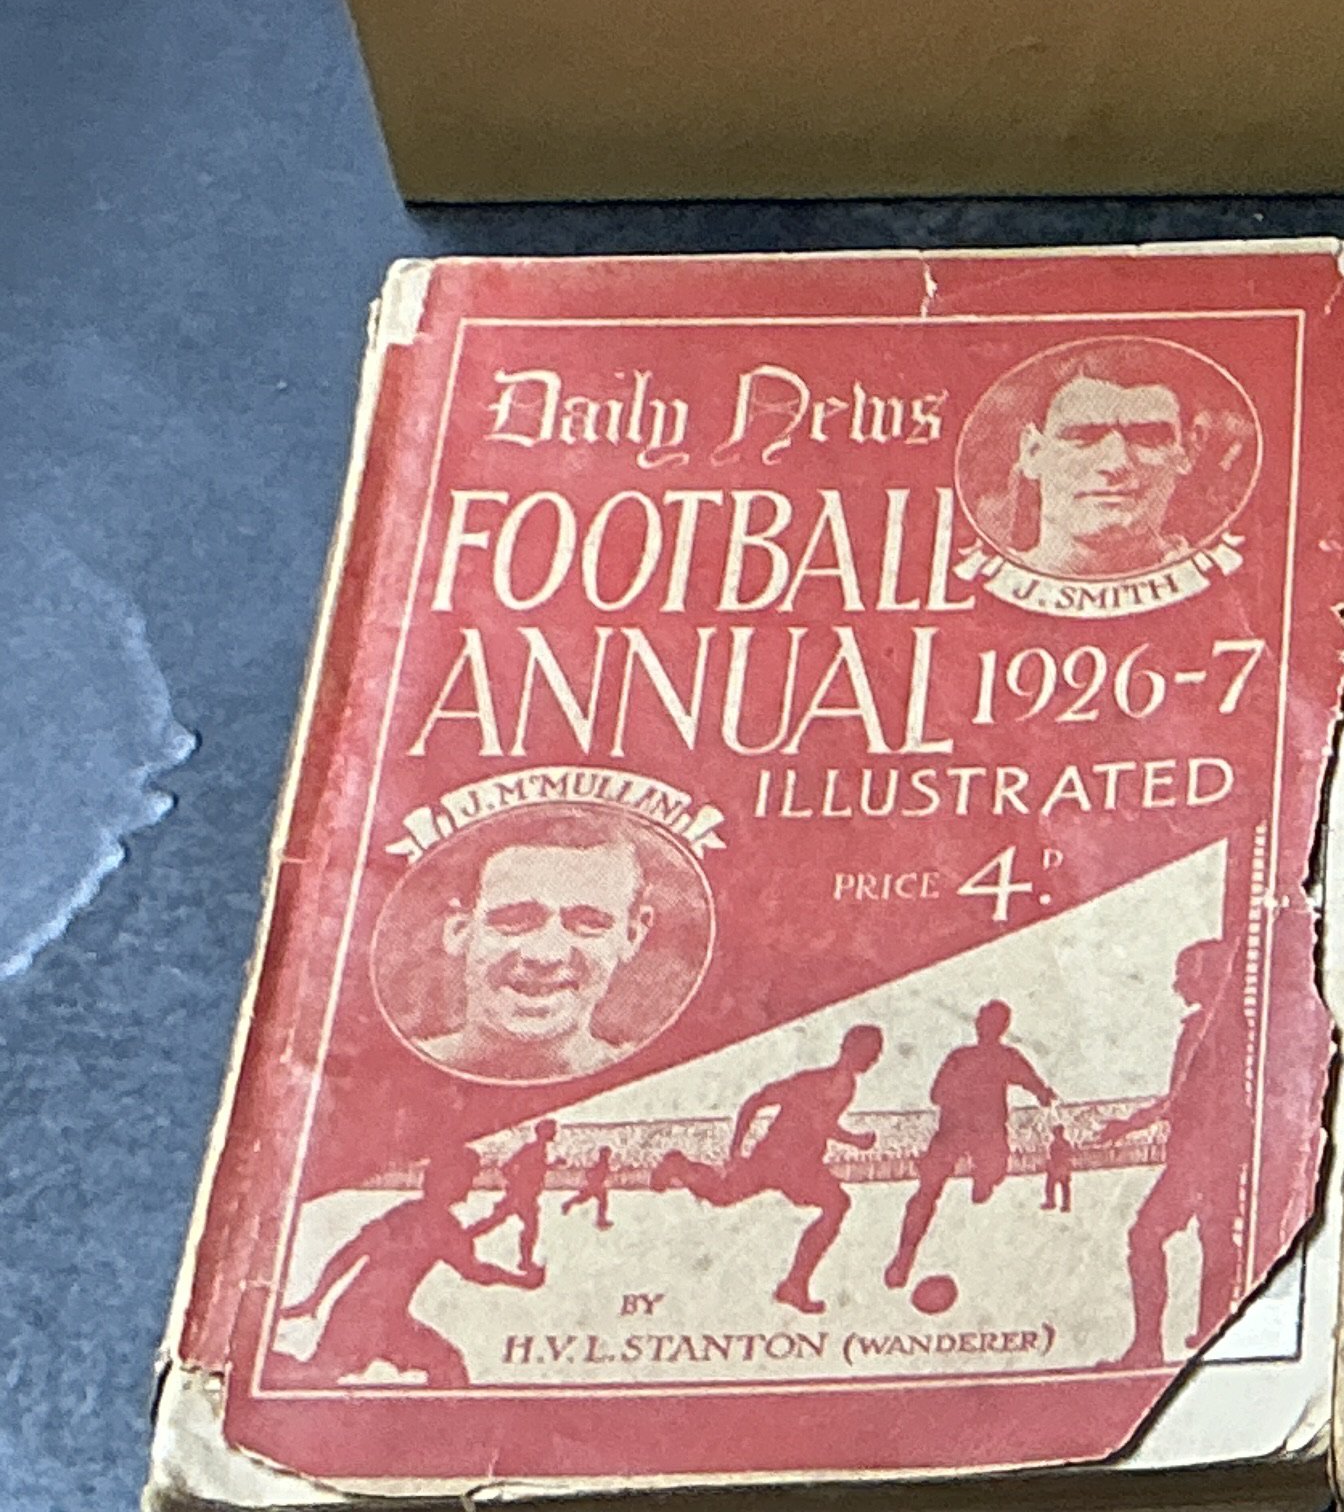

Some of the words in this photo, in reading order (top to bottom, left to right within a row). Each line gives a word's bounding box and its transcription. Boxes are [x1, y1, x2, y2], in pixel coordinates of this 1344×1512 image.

[483, 368, 690, 469] Daily
[709, 365, 949, 467] News
[430, 488, 980, 614] FOOTBALL
[409, 623, 957, 759] ANNUAL
[971, 637, 1267, 726] 1926-7
[754, 756, 1235, 819] ILLUSTRATED
[833, 872, 940, 901] PRICE
[620, 1293, 666, 1316] BY
[843, 1322, 1056, 1366] (WANDERER)
